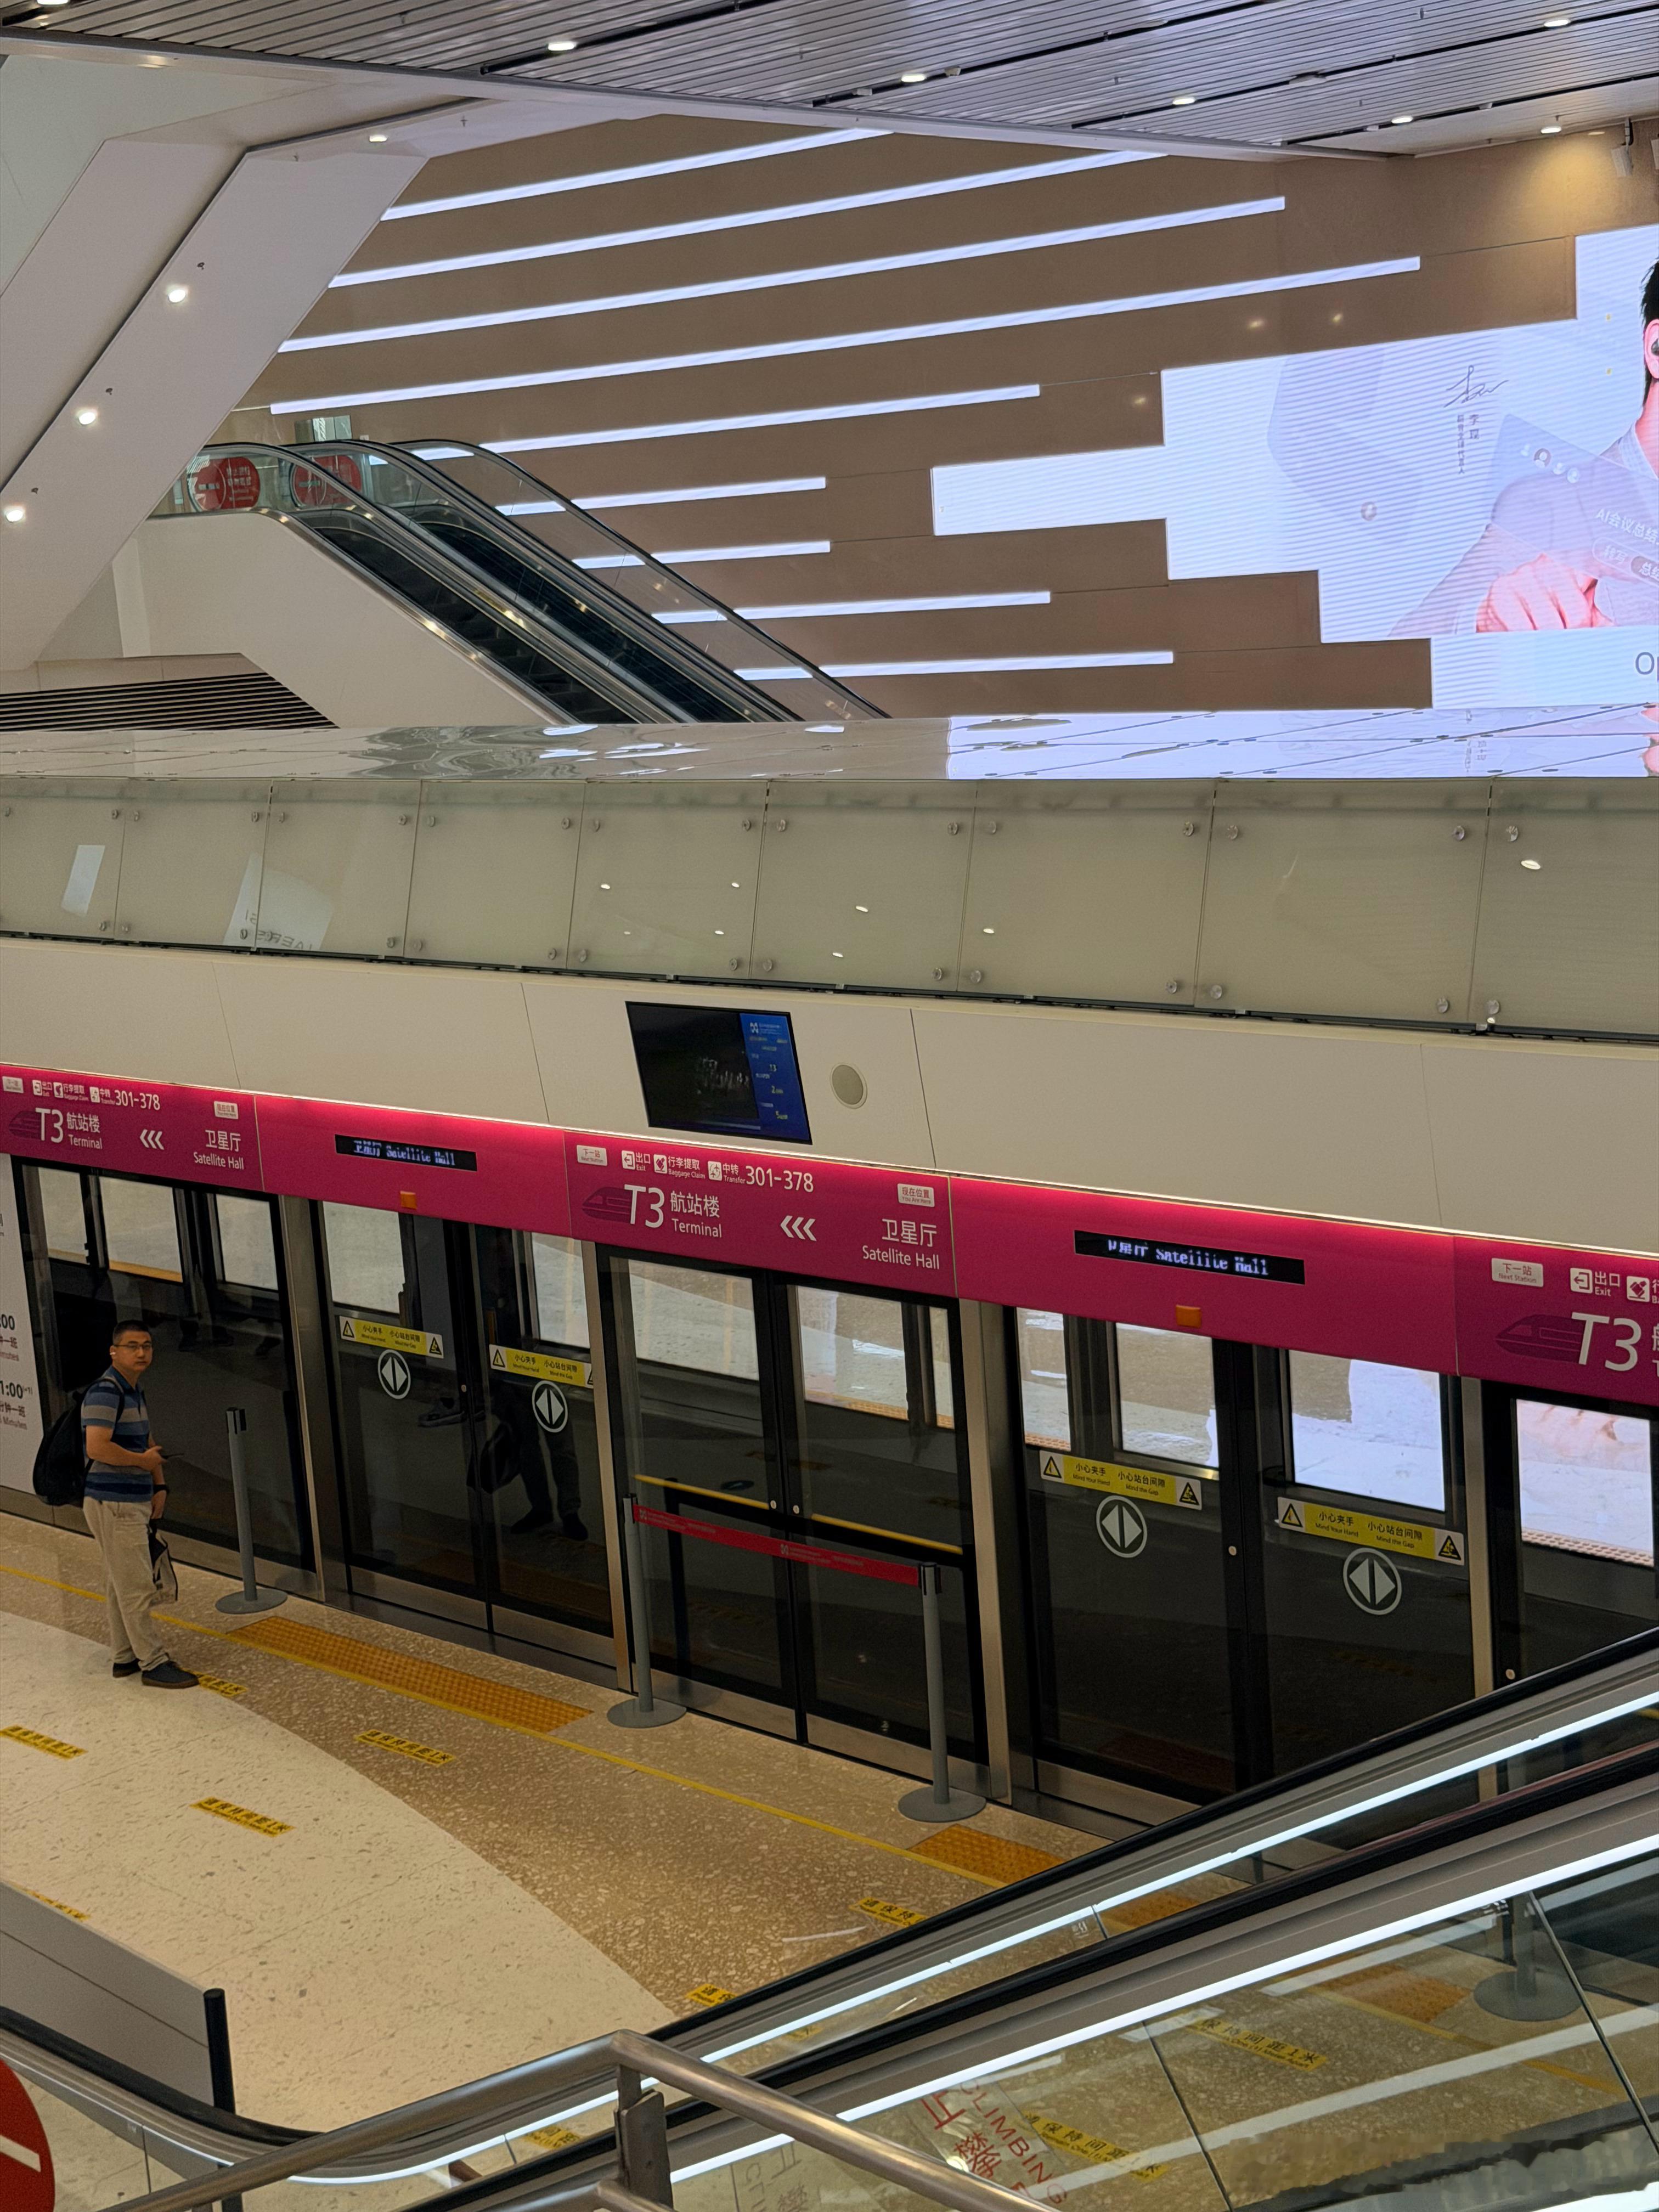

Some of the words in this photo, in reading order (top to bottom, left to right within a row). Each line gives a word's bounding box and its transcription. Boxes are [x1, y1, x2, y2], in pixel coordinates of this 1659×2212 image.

[1635, 652, 1659, 682] O
[115, 1089, 160, 1110] 301-378
[35, 1107, 64, 1143] T3
[66, 1111, 100, 1133] 航站楼
[67, 1134, 103, 1149] Terminal
[205, 1129, 241, 1152] 卫星厅
[194, 1152, 226, 1167] Satellite
[228, 1155, 244, 1170] Hall
[635, 1152, 651, 1165] 出口
[668, 1156, 700, 1171] 行李提取
[668, 1169, 690, 1178] Baggage
[723, 1163, 739, 1176] 中转
[724, 1175, 746, 1184] Transfer
[746, 1165, 814, 1193] 301-378
[624, 1184, 664, 1228] T3
[670, 1190, 720, 1218] 航站楼
[672, 1218, 722, 1238] Terminal
[882, 1218, 937, 1247] 卫星厅
[862, 1245, 911, 1266] Satellite
[916, 1252, 939, 1269] Hall
[1502, 1263, 1532, 1276] 下一站
[1515, 1274, 1537, 1283] Station
[1594, 1271, 1620, 1287] 出口
[1595, 1286, 1611, 1297] Exit
[1571, 1312, 1641, 1372] T3
[1075, 1463, 1106, 1476] 小心夹手
[1118, 1471, 1165, 1488] 小心站台间隙
[1319, 1511, 1354, 1527] 小心夹手
[1316, 1523, 1329, 1532] Mind
[1330, 1526, 1342, 1534] Your
[1344, 1528, 1359, 1537] Hand
[1368, 1521, 1422, 1541] 小心站台间隙
[1376, 1536, 1391, 1544] Mind
[1402, 1541, 1414, 1549] Gap
